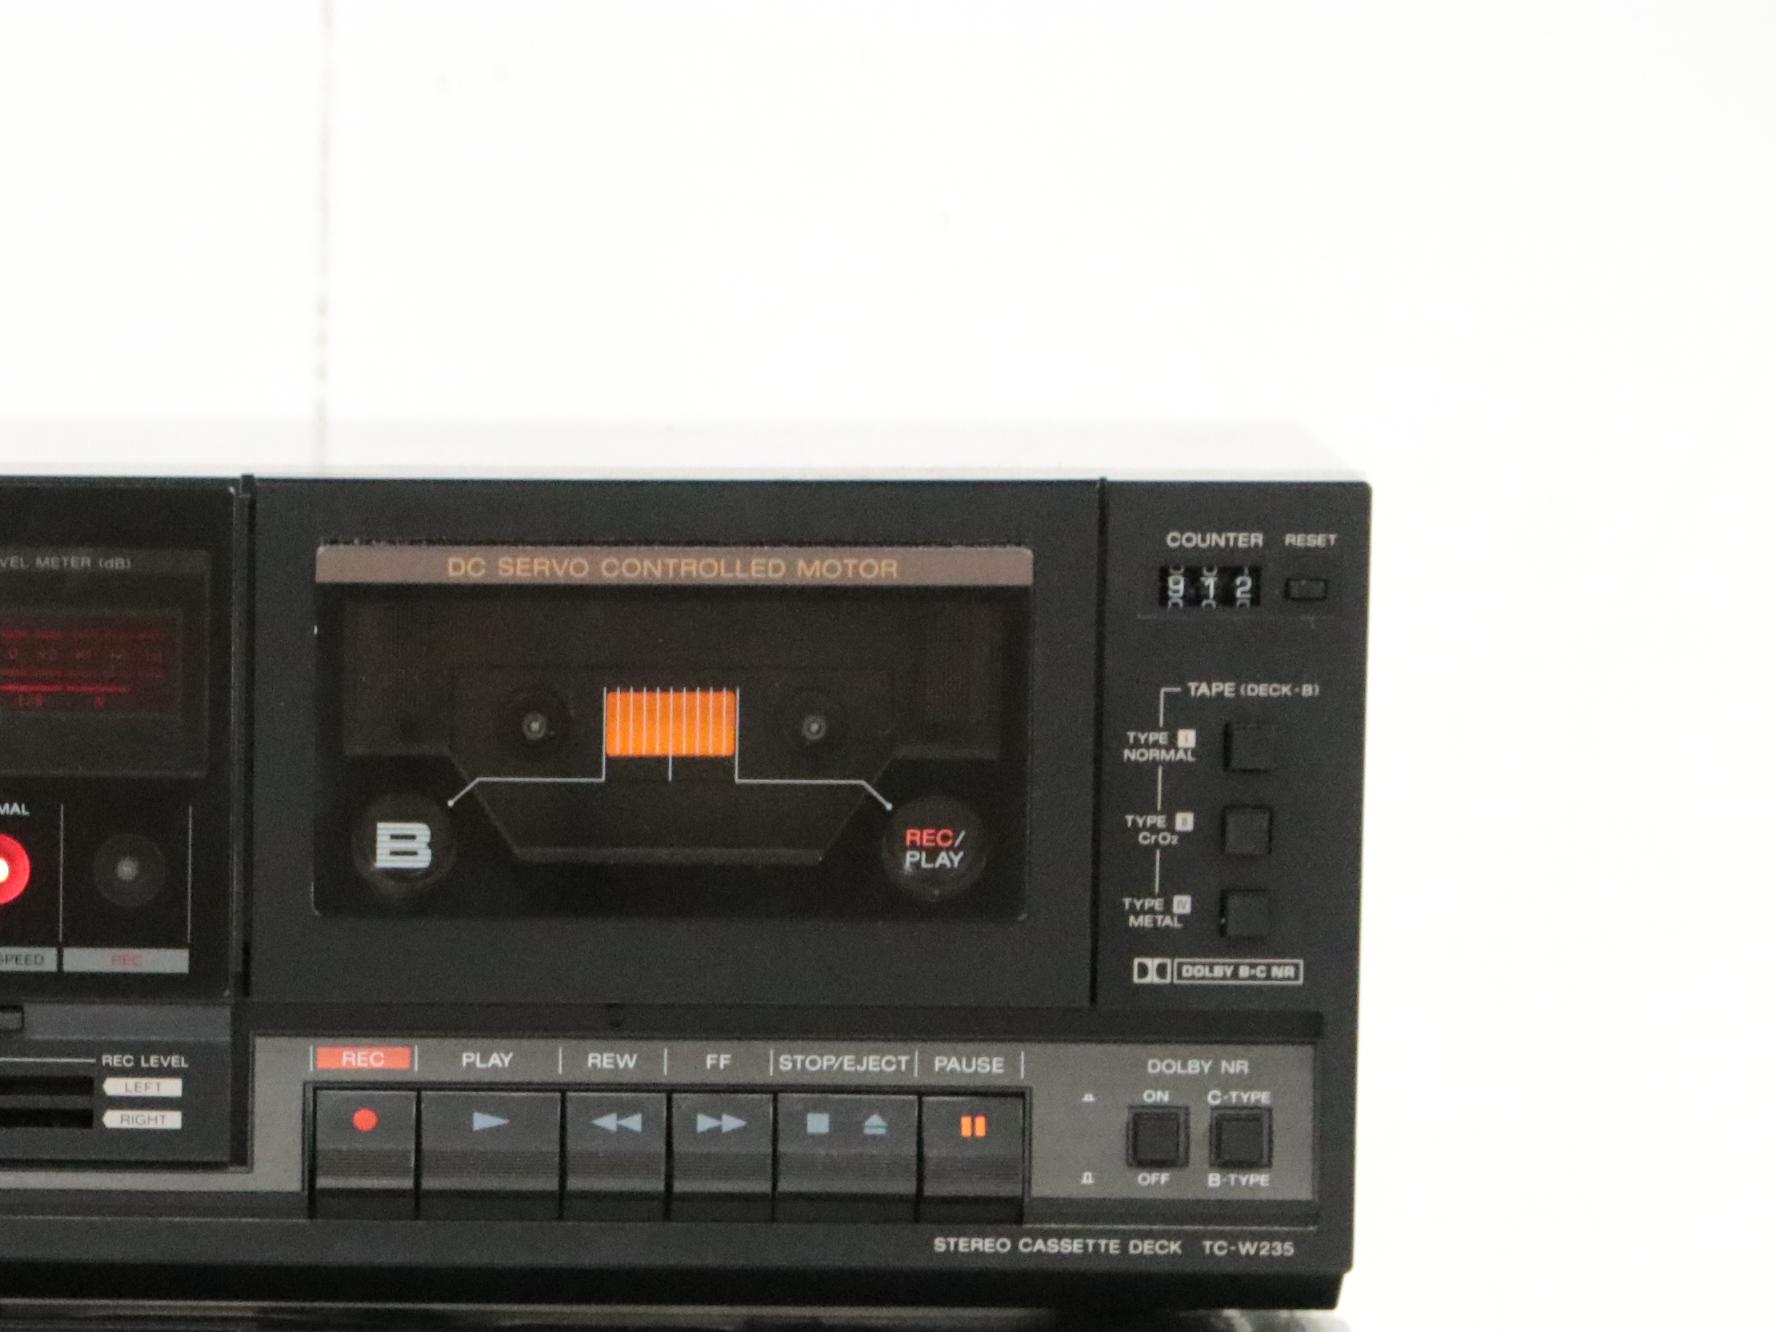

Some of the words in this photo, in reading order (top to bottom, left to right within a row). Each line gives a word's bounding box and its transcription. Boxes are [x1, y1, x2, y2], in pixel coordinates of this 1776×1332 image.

[1166, 532, 1263, 548] COUNTER
[1285, 533, 1337, 548] RESET
[36, 555, 92, 569] METER
[99, 556, 132, 571] (dB)
[448, 557, 486, 578] DC
[498, 557, 589, 578] SERVO
[601, 558, 786, 579] CONTROLLED
[797, 558, 900, 579] MOTOR
[1167, 576, 1254, 598] 912
[1187, 681, 1235, 698] TAPE
[1126, 731, 1169, 746] TYPE
[1123, 748, 1197, 763] NORMAL
[1125, 814, 1167, 830] TYPE
[375, 822, 432, 869] B
[905, 829, 965, 848] REC/
[905, 850, 965, 869] PLAY
[1123, 898, 1164, 913] TYPE
[1129, 915, 1182, 929] METAL
[111, 953, 143, 967] REC
[1182, 964, 1233, 979] DOLBY
[1272, 966, 1295, 979] NR
[102, 1054, 135, 1068] REC
[141, 1055, 189, 1068] LEVEL
[341, 1052, 384, 1066] REC
[462, 1053, 513, 1068] PLAY
[588, 1054, 638, 1068] REW
[706, 1055, 731, 1069] FF
[779, 1055, 910, 1073] STOP/EJECT
[934, 1057, 1004, 1074] PAUSE
[1147, 1059, 1213, 1075] DOLBY
[1220, 1060, 1249, 1075] NR
[124, 1081, 163, 1093] LEFT
[1143, 1090, 1170, 1103] ON
[1207, 1090, 1272, 1105] C-TYPE
[120, 1114, 166, 1126] RIGHT
[1137, 1173, 1170, 1186] OFF
[1207, 1173, 1270, 1187] B-TYPE
[933, 1238, 1011, 1253] STEREO
[1018, 1238, 1121, 1255] CASSETTE
[1128, 1239, 1182, 1255] DECK
[1202, 1240, 1294, 1256] TC-W235
